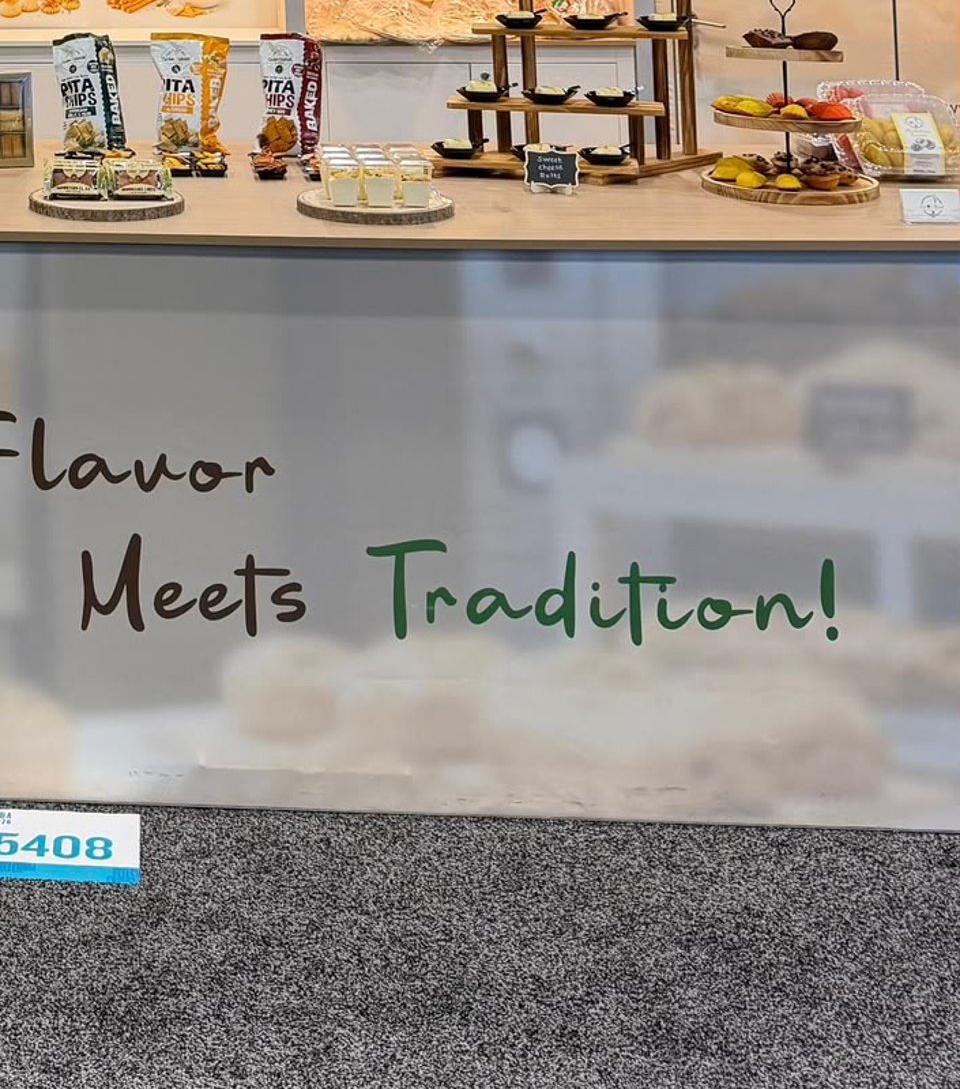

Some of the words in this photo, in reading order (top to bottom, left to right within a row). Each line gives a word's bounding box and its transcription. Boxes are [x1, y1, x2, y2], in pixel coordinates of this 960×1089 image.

[60, 78, 95, 98] PITA
[162, 78, 196, 93] ITA
[105, 73, 122, 126] BAKED
[164, 92, 196, 107] HIPS
[265, 93, 295, 108] HIPS
[304, 80, 319, 132] BAKED
[80, 532, 307, 638] Meets
[366, 538, 840, 647] Tradition!
